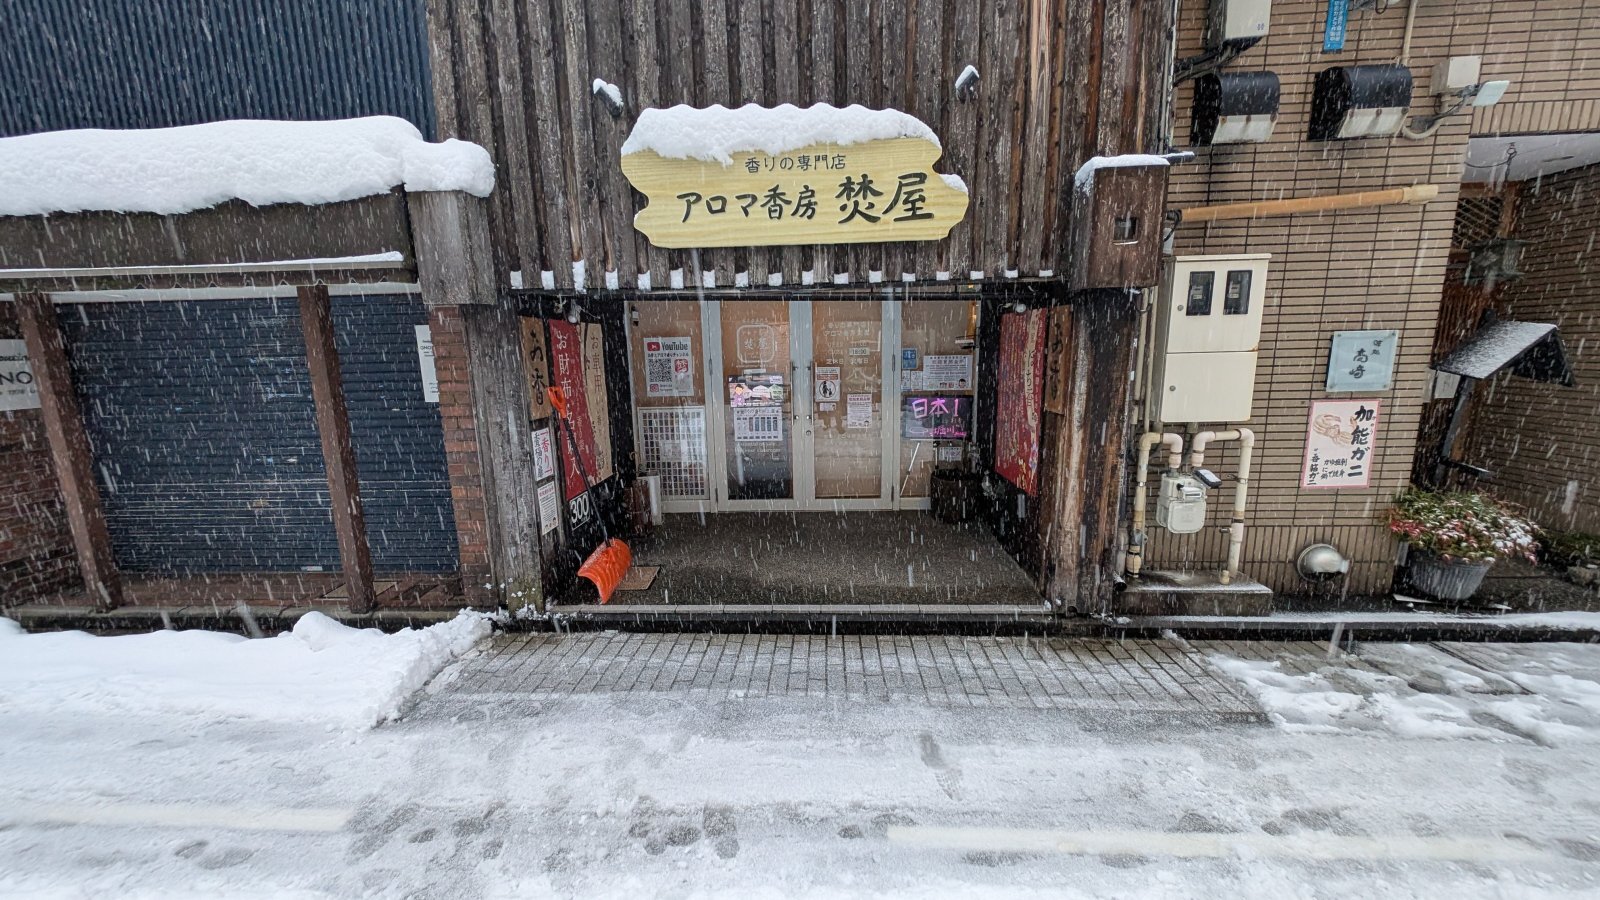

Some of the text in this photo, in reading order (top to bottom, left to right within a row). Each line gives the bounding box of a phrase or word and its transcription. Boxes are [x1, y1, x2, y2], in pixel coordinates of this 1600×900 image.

[677, 172, 935, 224] アロマ香房 焚屋
[661, 341, 689, 351] YouTube
[569, 494, 589, 523] 300
